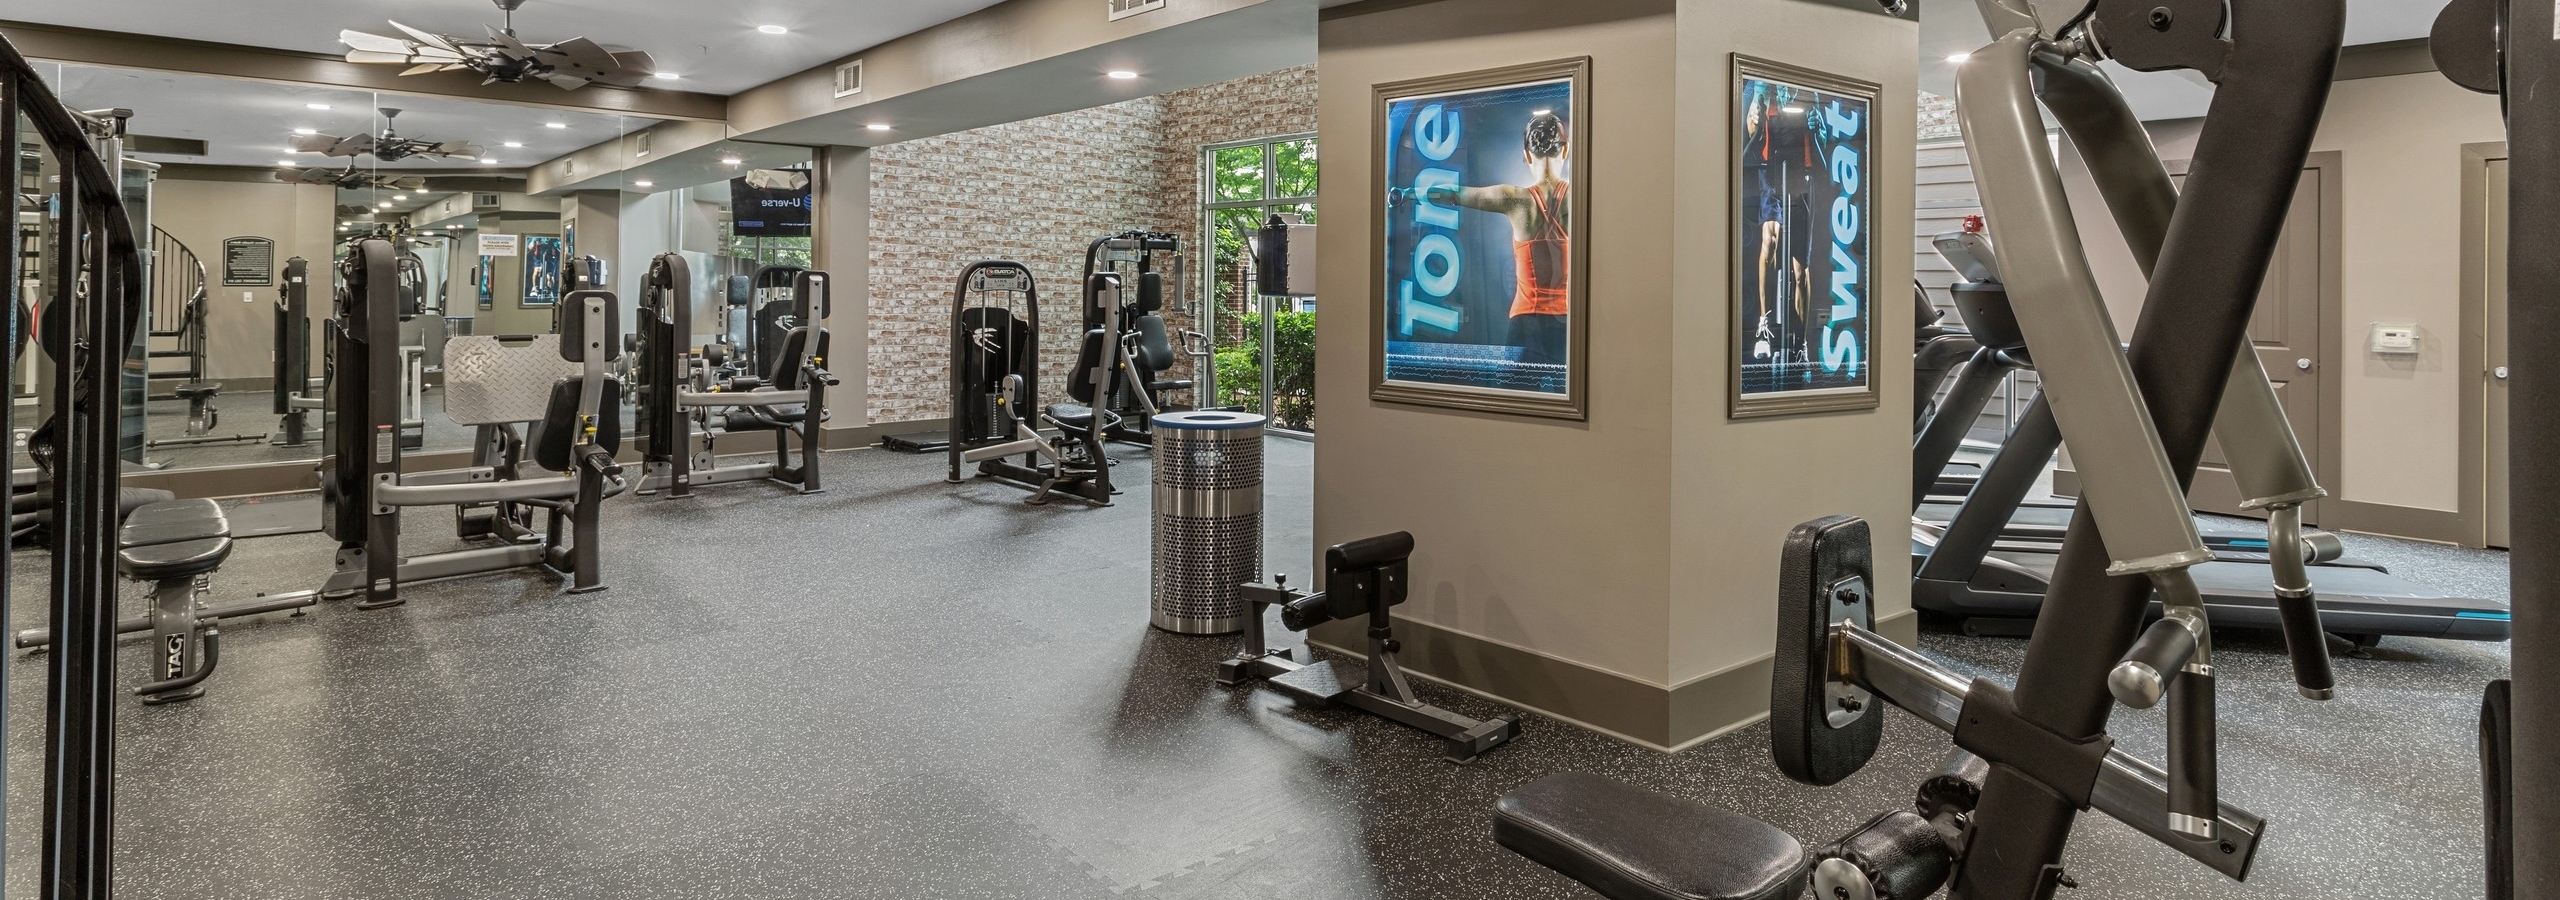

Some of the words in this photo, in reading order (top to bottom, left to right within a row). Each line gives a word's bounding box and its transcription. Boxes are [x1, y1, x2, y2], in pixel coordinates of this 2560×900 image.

[1400, 103, 1461, 337] Tone
[1822, 99, 1859, 379] Sweat
[167, 637, 184, 678] TAG
